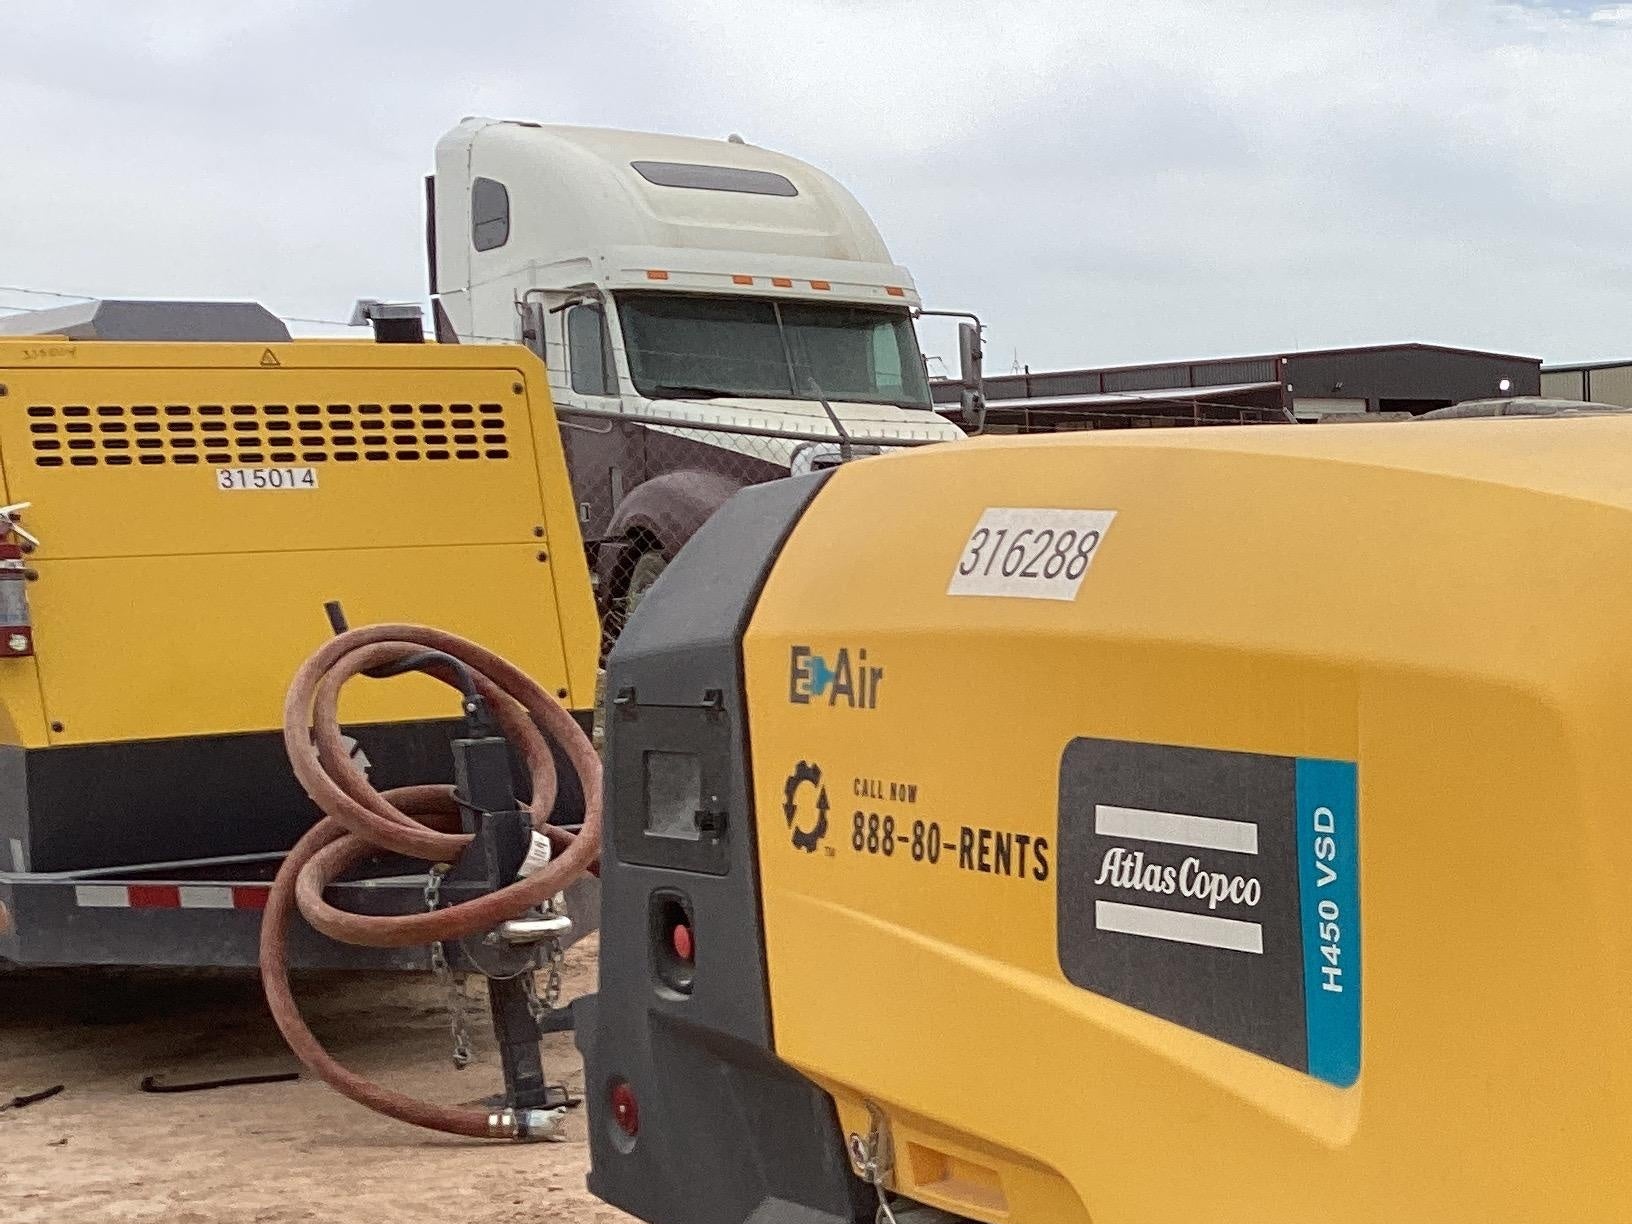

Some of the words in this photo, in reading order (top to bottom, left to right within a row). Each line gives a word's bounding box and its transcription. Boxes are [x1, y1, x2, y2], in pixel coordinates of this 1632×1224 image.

[220, 468, 314, 489] 315014
[959, 528, 1100, 581] 316288
[853, 777, 883, 800] CALL
[889, 782, 918, 803] NOW
[852, 810, 1050, 882] 888-80-RENTS
[1313, 806, 1338, 888] VSD
[1094, 847, 1177, 895] Atlas
[1178, 856, 1261, 910] Copco
[1316, 900, 1343, 993] H450
